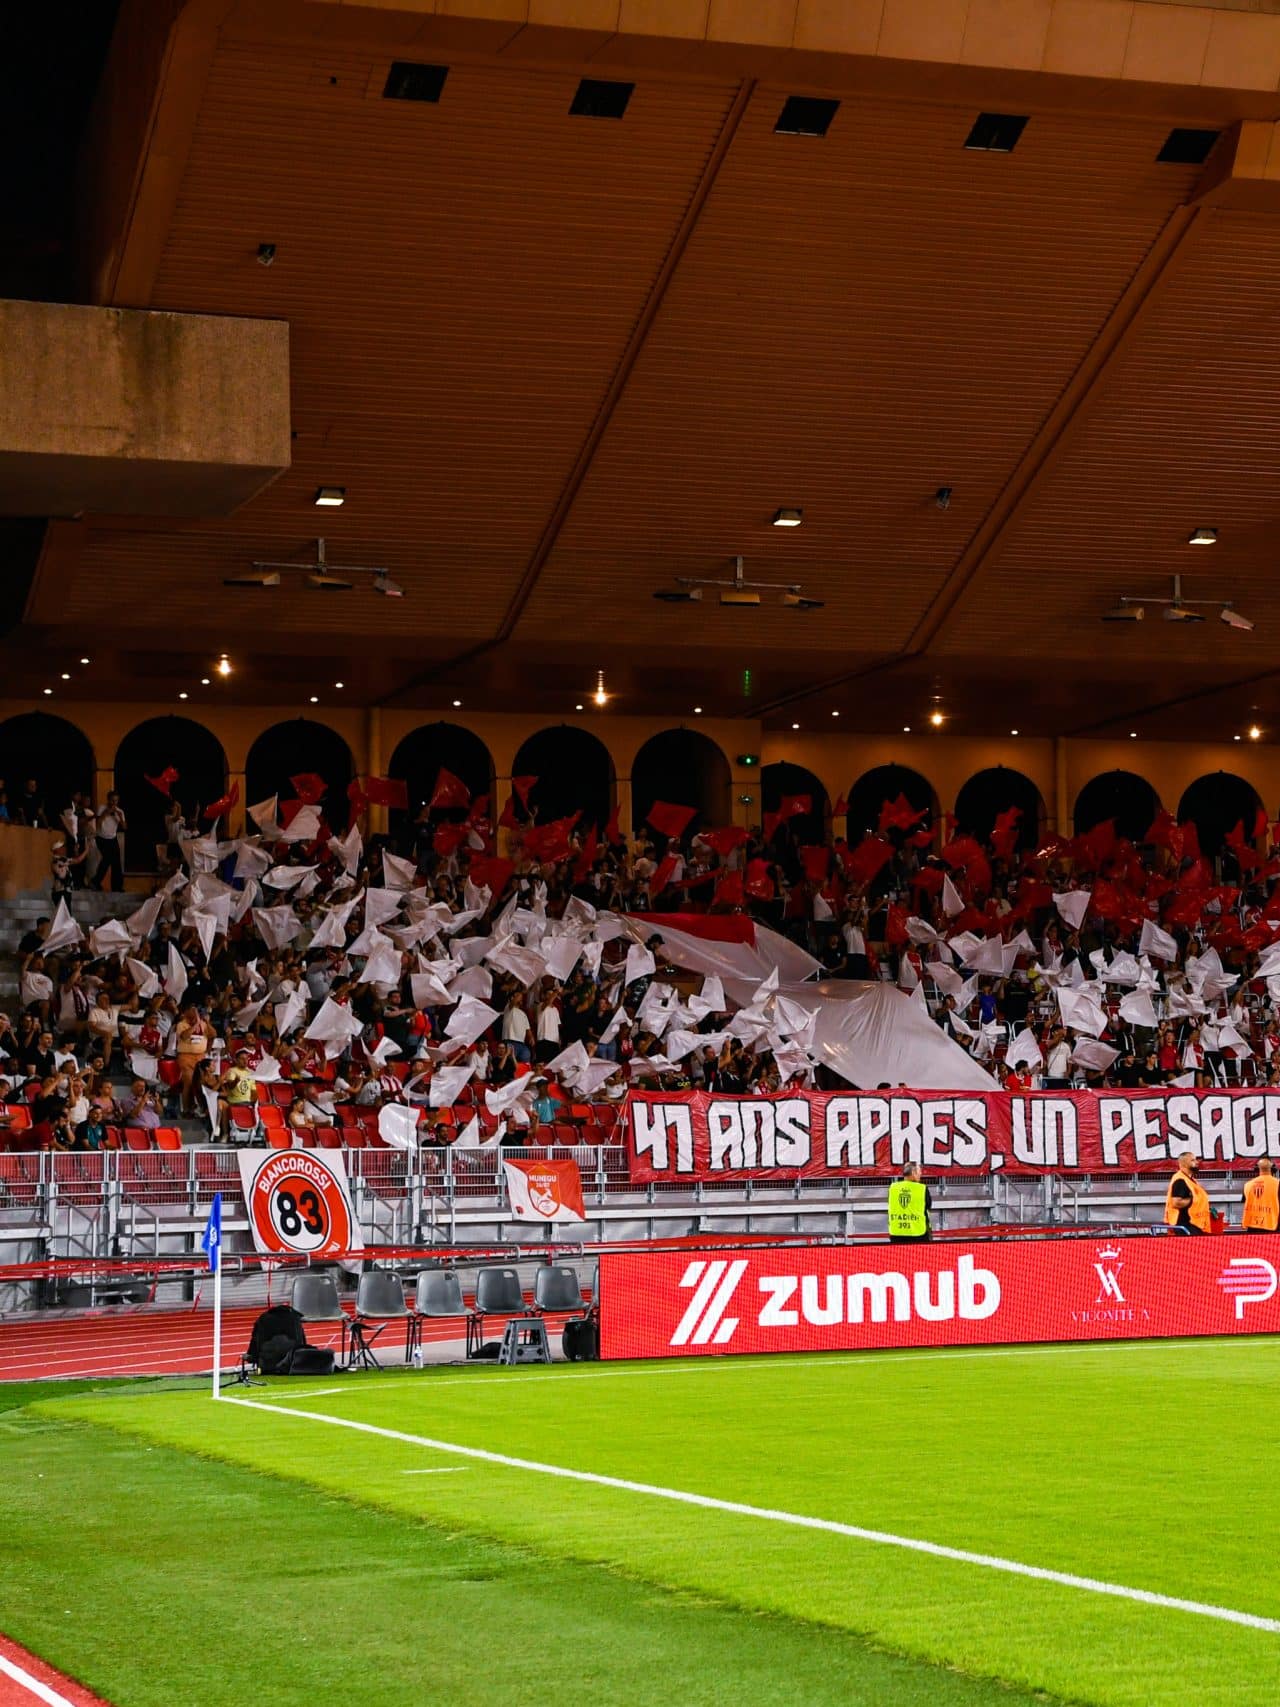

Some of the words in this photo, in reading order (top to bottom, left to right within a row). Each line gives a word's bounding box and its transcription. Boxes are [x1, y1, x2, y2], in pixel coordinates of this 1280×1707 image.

[632, 1100, 694, 1173] 41
[708, 1099, 811, 1170] ANS
[1011, 1097, 1078, 1168] UN
[258, 1157, 331, 1194] BIANCOROSSI
[277, 1190, 323, 1236] 83
[758, 1253, 1001, 1326] zumub
